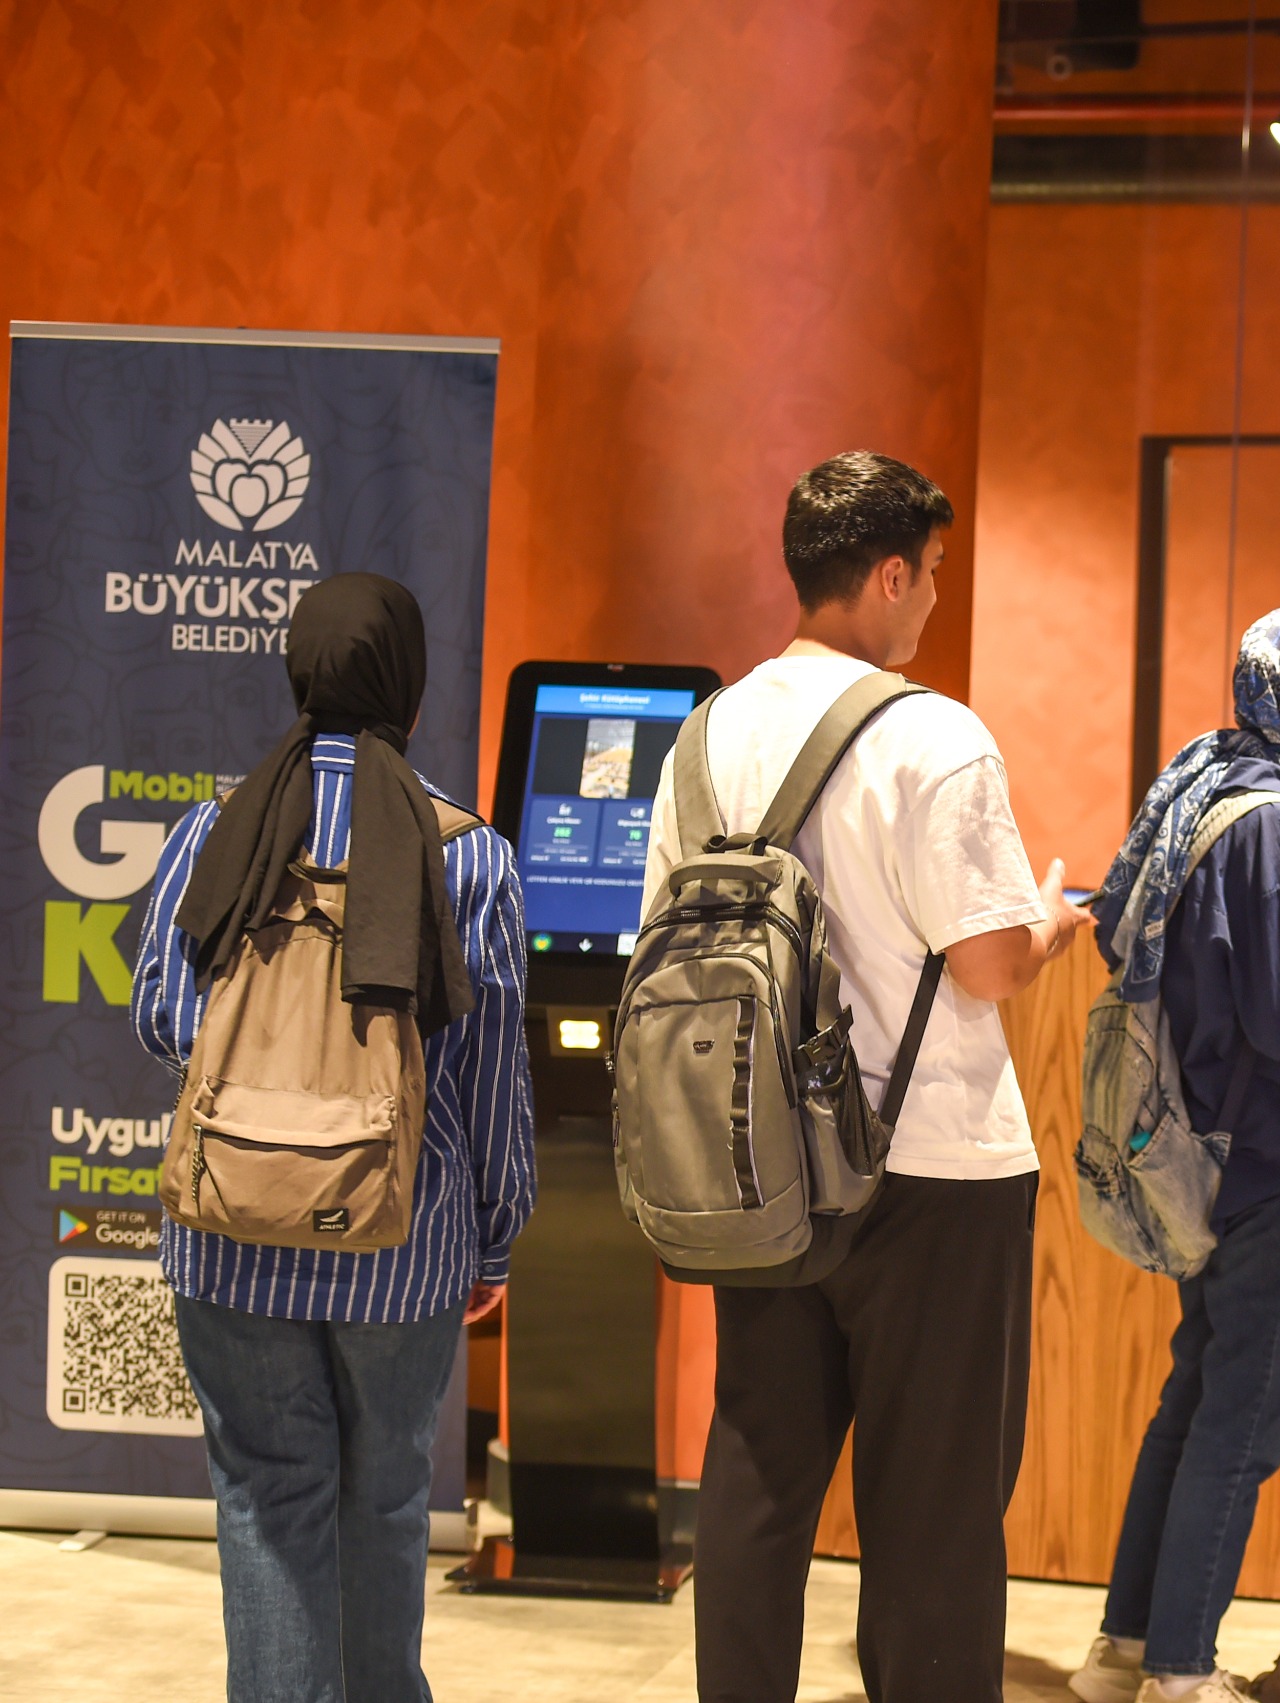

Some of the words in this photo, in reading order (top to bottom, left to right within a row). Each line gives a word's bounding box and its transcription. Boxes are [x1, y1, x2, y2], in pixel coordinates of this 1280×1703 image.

[175, 539, 319, 571] MALATYA
[105, 571, 321, 624] BÜYÜKŞE
[109, 769, 214, 801] Mobil
[96, 1210, 117, 1222] GET
[119, 1212, 128, 1222] IT
[129, 1212, 145, 1224] ON
[96, 1223, 159, 1249] Google
